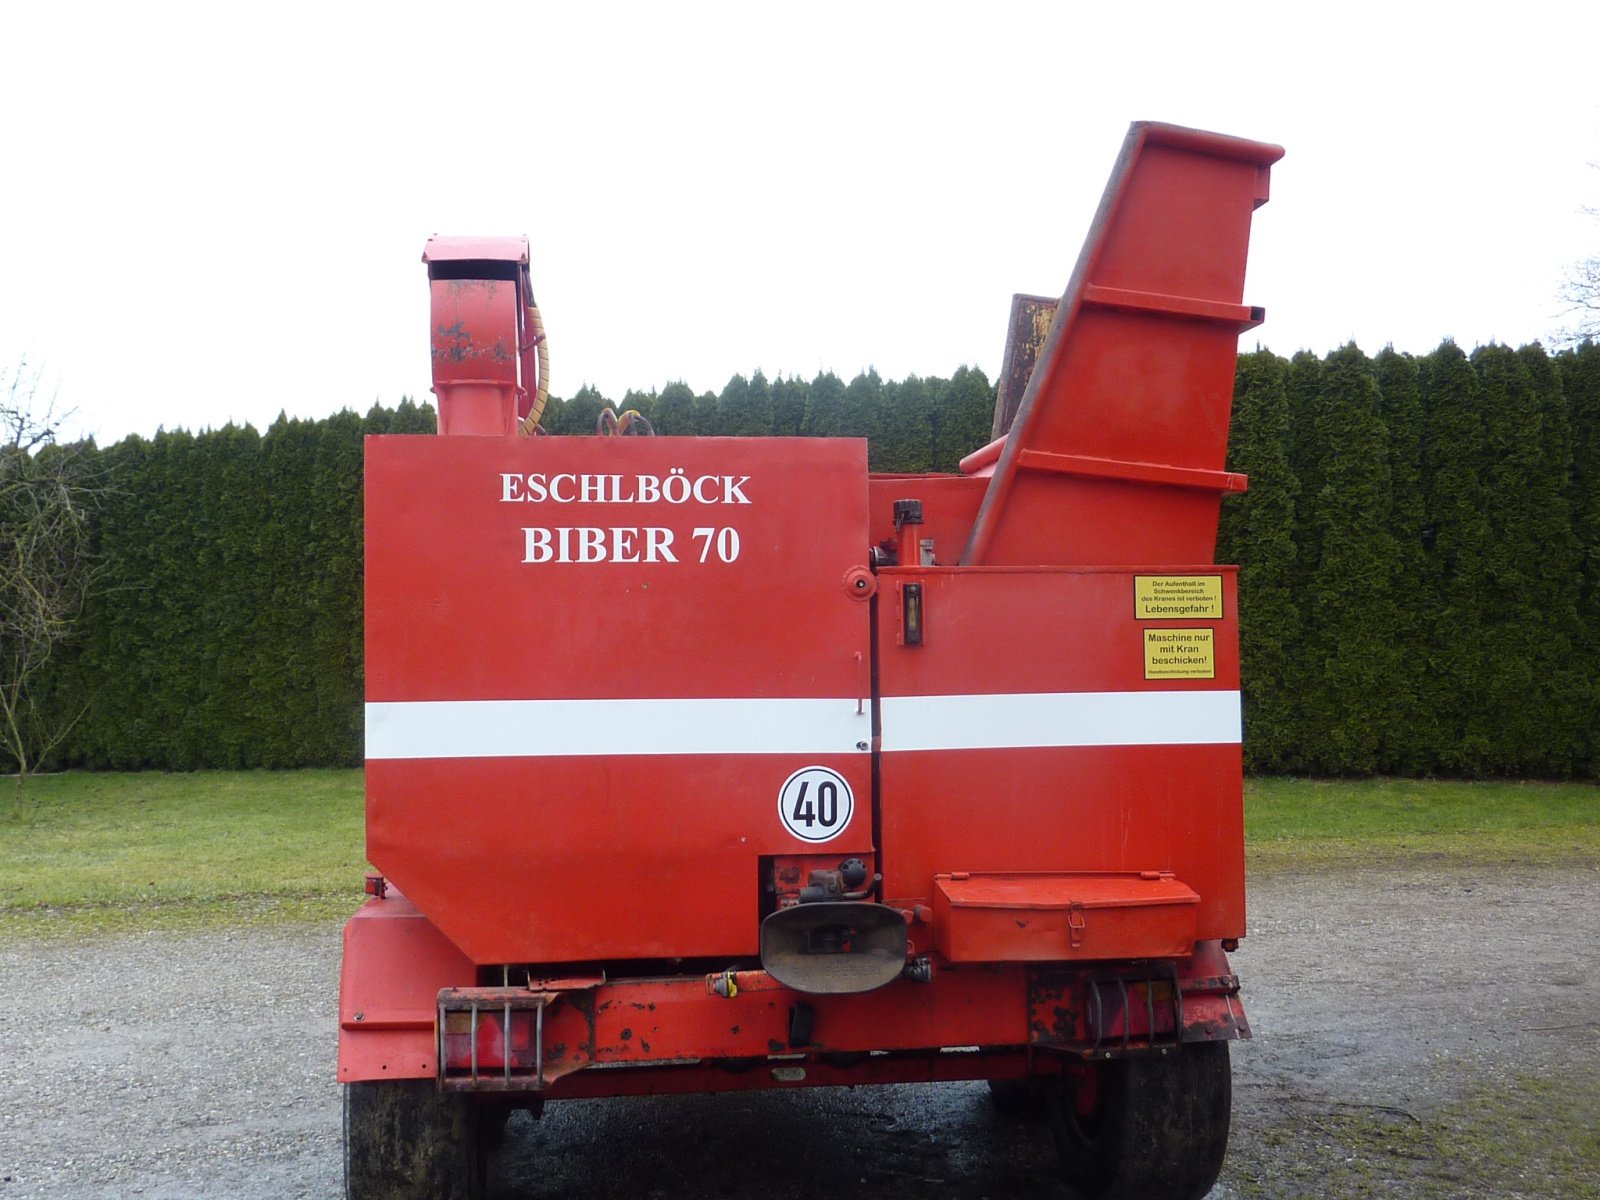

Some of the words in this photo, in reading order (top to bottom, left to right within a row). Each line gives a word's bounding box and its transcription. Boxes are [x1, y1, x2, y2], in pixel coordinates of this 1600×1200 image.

[499, 467, 752, 504] ESCHLBÖCK
[520, 527, 680, 563] BIBER
[691, 526, 740, 563] 70
[1145, 605, 1209, 614] Lebensgefahr
[1148, 633, 1192, 642] Maschine
[1194, 634, 1210, 642] nur
[1160, 645, 1175, 653] mit
[1176, 645, 1199, 653] Kran
[1152, 656, 1207, 665] beschicken!
[793, 781, 837, 827] 40
